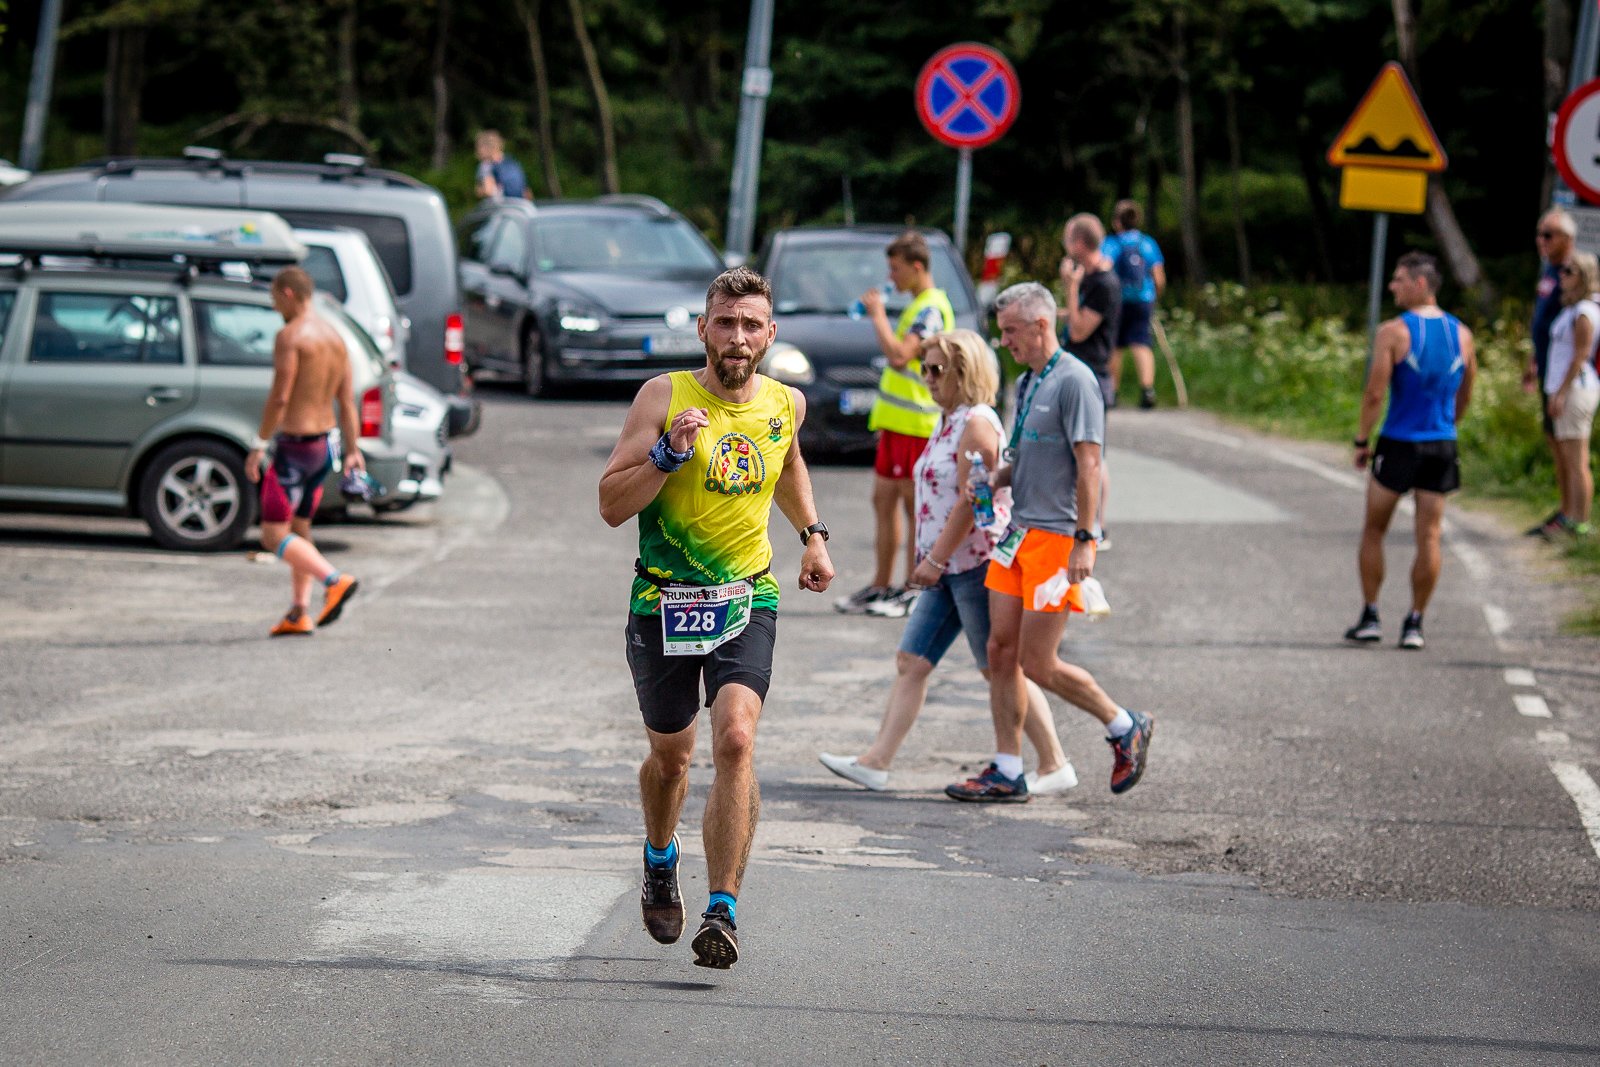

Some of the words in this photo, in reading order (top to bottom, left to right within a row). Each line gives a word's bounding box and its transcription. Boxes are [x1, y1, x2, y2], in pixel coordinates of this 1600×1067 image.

[704, 478, 763, 496] OLAWS
[727, 587, 746, 597] BIEG
[673, 611, 716, 632] 228
